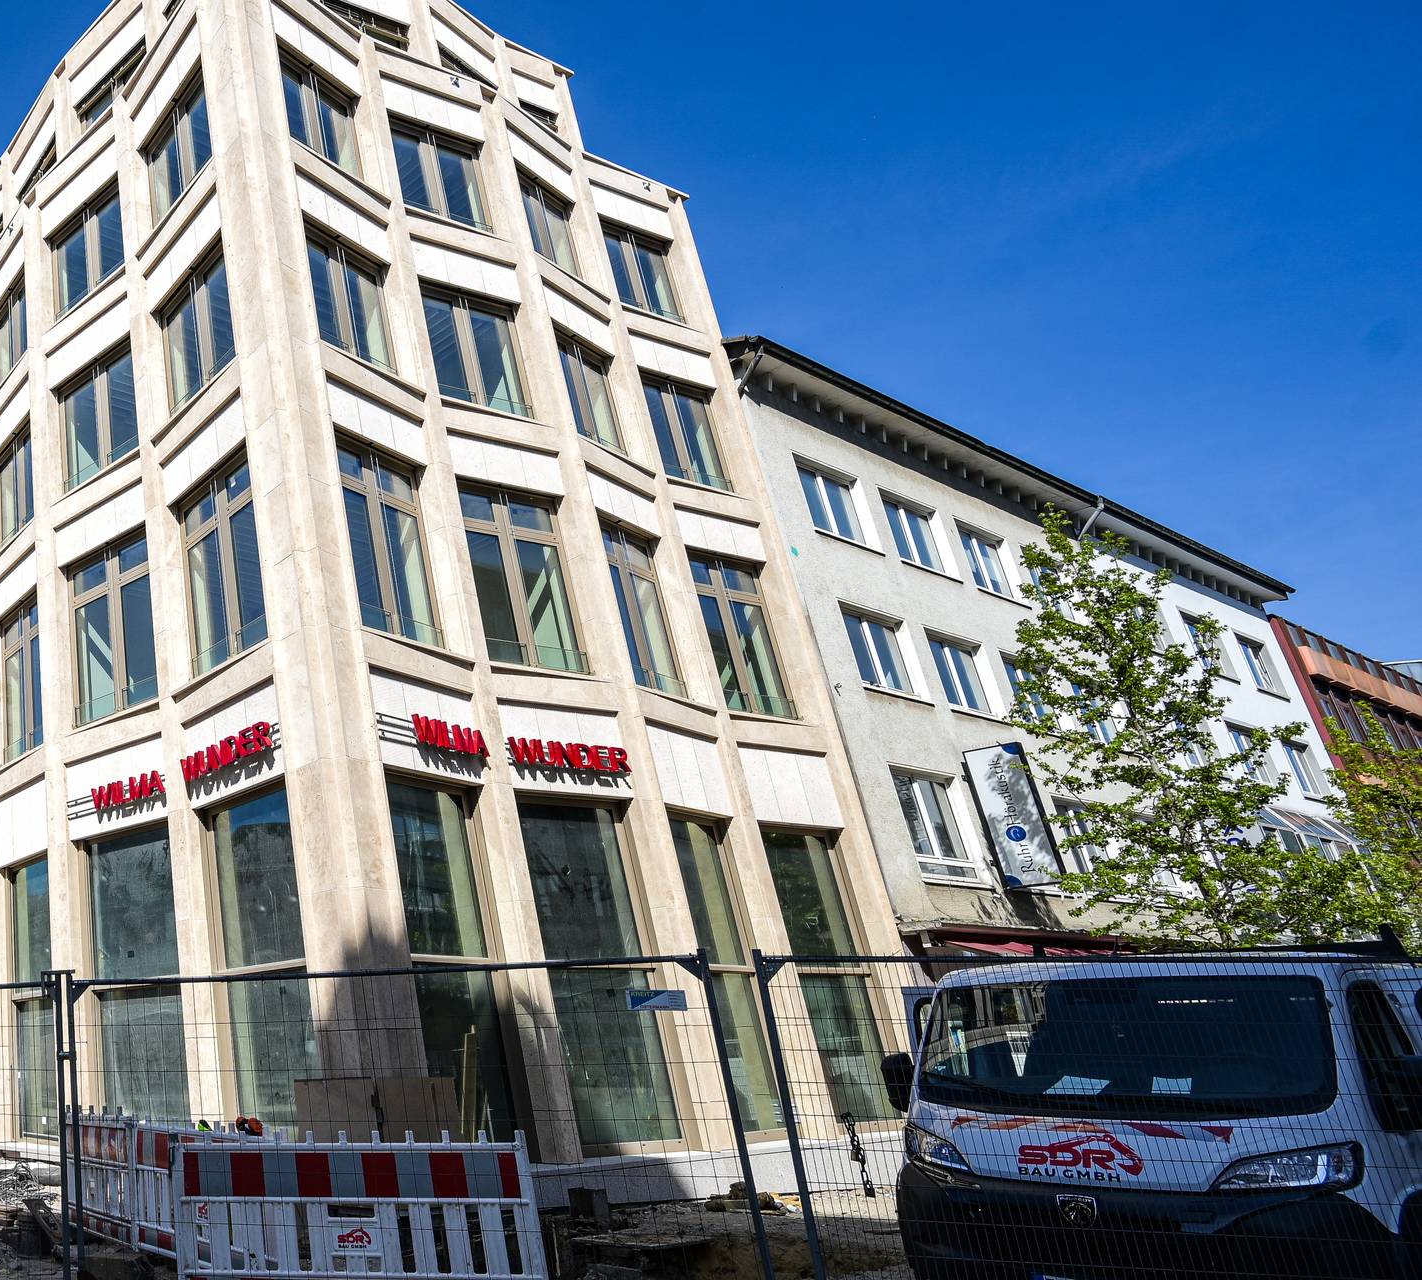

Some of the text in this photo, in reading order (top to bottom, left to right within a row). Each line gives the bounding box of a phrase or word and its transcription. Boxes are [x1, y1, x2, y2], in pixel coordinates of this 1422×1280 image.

[411, 713, 632, 773] WILMA WUNDER
[91, 721, 274, 809] WILMA WUNDER
[988, 757, 1036, 874] Ruhr Hörakustik
[1018, 1144, 1116, 1171] SDR
[1018, 1166, 1121, 1182] BAU GMBH
[337, 1234, 365, 1244] SDR
